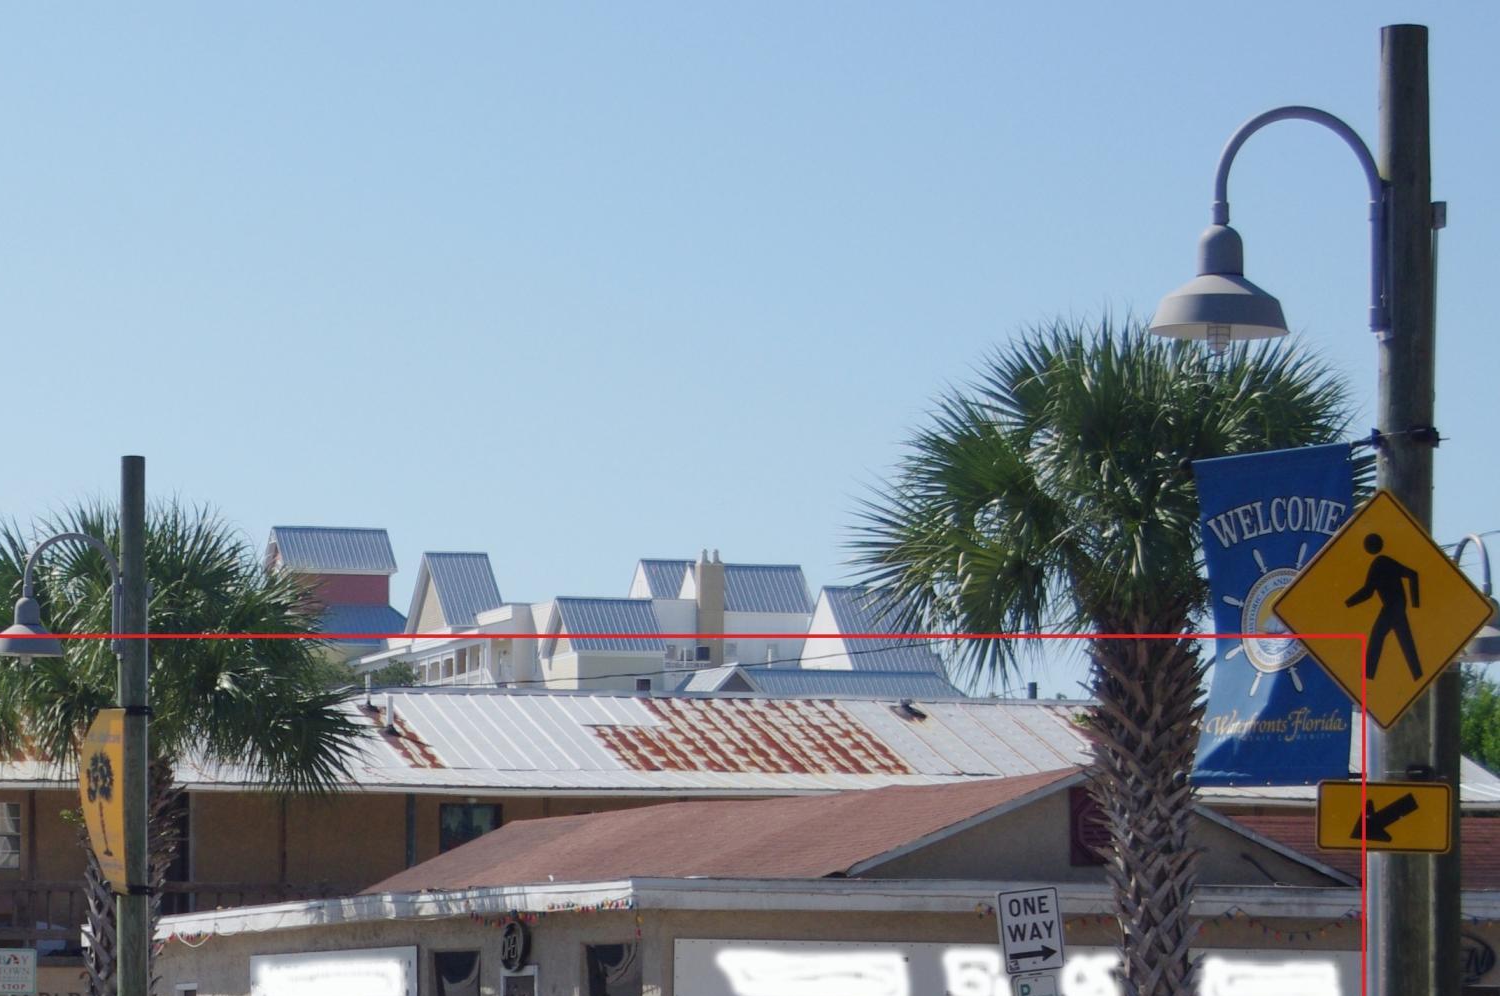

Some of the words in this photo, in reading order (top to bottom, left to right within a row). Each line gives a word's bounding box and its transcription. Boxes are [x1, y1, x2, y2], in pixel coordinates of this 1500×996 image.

[1207, 496, 1346, 548] WELCOME
[1206, 709, 1287, 738] Waterfronts
[1284, 706, 1348, 742] Florida
[1008, 895, 1050, 917] ONE
[1007, 920, 1054, 942] WAY
